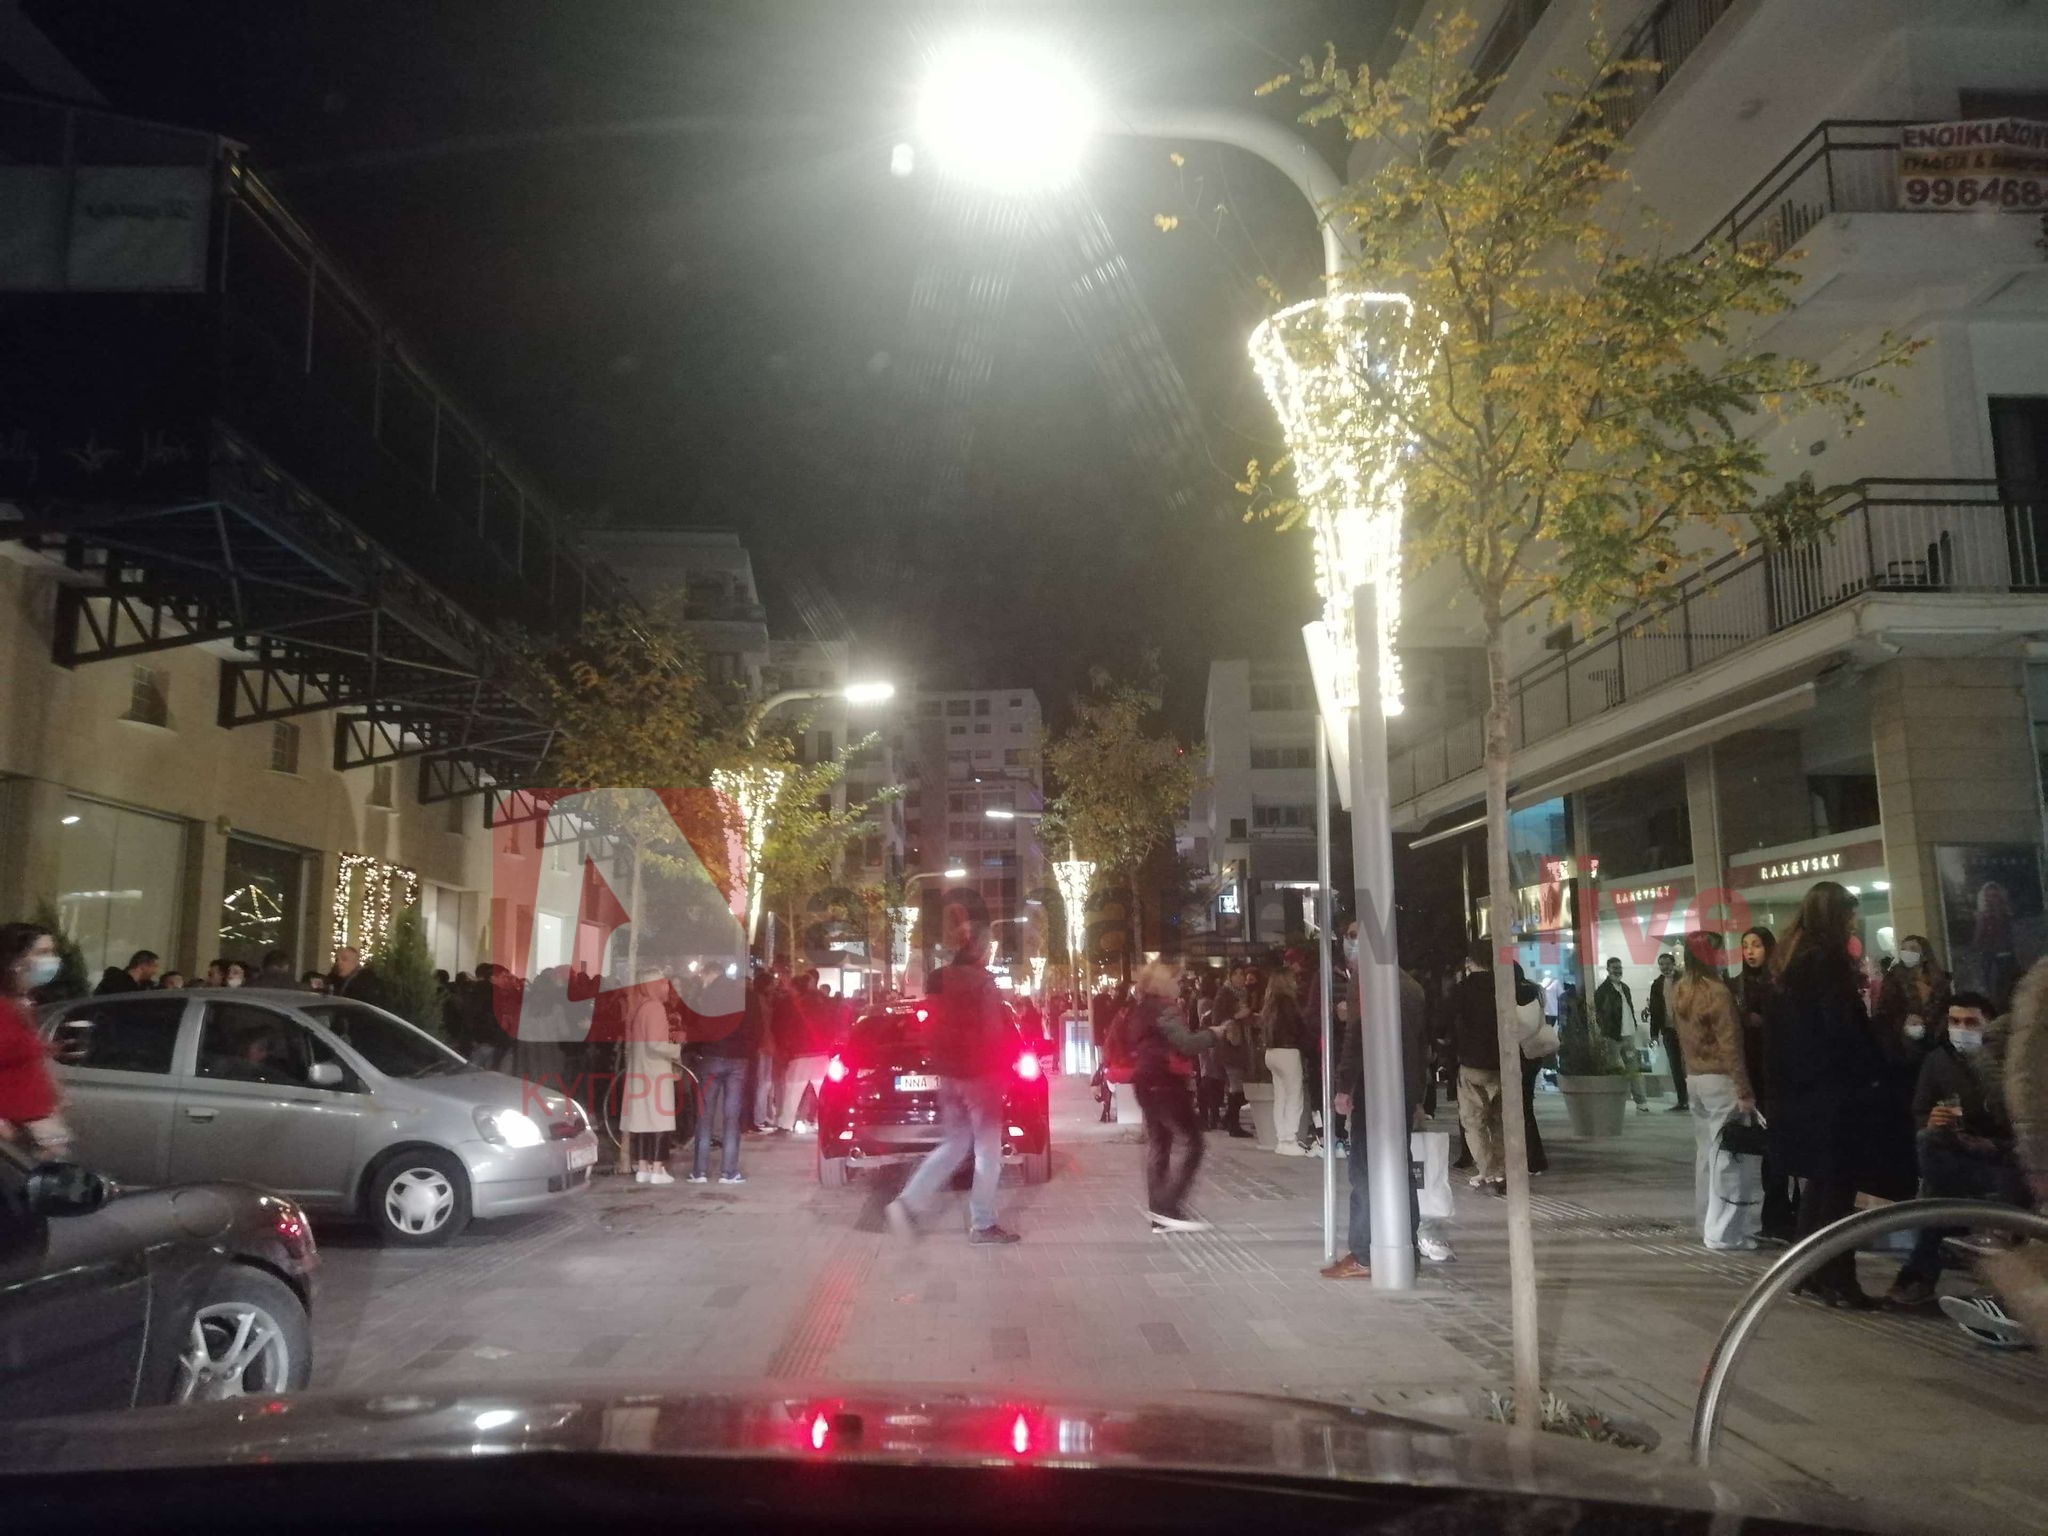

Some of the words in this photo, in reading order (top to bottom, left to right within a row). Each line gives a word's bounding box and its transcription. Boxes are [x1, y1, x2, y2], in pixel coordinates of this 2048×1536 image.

[1906, 178, 2048, 206] 996468
[1759, 852, 1840, 880] RAXEVSKY
[904, 1077, 927, 1088] NNA
